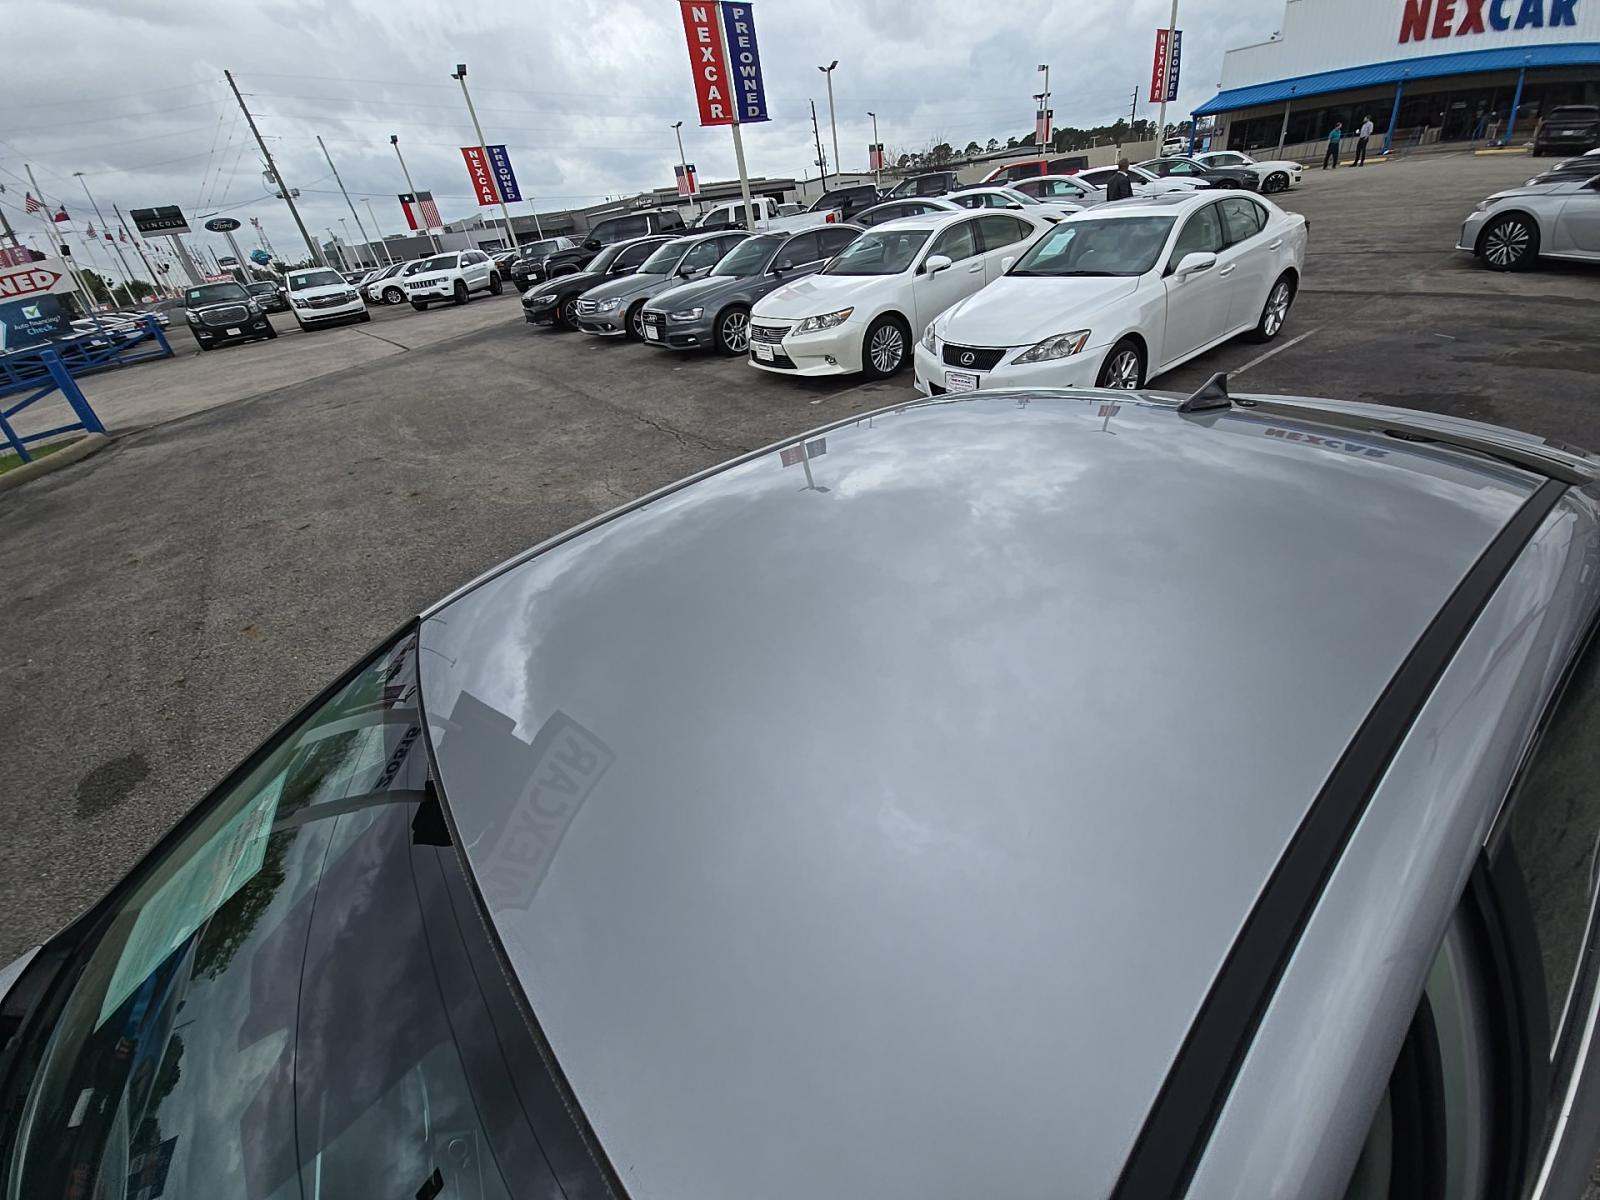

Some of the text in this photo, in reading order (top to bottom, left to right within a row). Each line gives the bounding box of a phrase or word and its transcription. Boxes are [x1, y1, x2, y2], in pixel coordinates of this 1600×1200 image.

[1398, 0, 1577, 43] NEXCAR
[691, 6, 724, 118] NEXCAR
[732, 8, 760, 117] PREOWNED
[1154, 33, 1166, 99] NEXCAR
[1168, 33, 1180, 98] PREOWNED
[468, 150, 493, 202] NEXCAR
[493, 148, 515, 200] PREOWNED
[141, 219, 184, 230] LINCOLN
[212, 221, 233, 230] Ford
